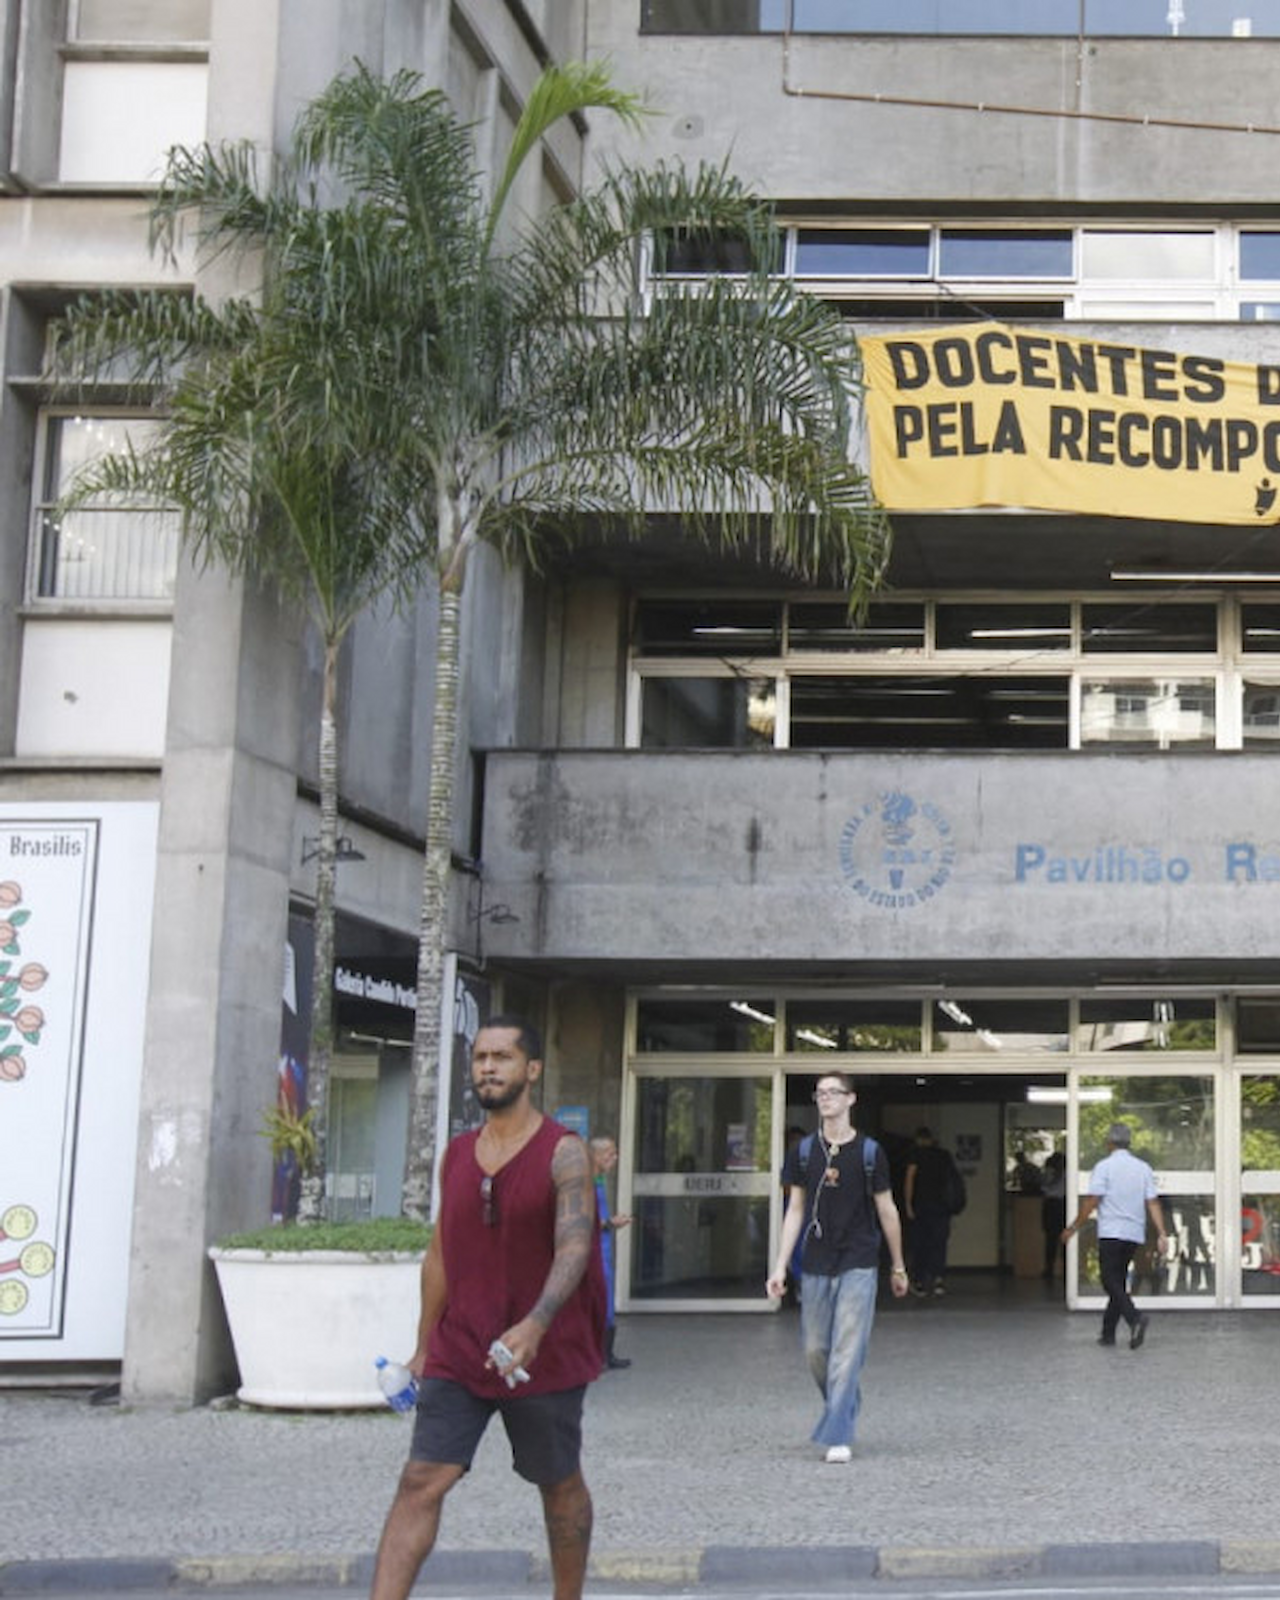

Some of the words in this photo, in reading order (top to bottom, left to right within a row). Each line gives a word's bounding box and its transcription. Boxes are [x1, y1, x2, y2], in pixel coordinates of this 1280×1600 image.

[886, 332, 1226, 402] DOCENTES
[893, 400, 1026, 459] PELA
[9, 835, 82, 857] Brasilis
[1016, 844, 1190, 884] Pavilhão
